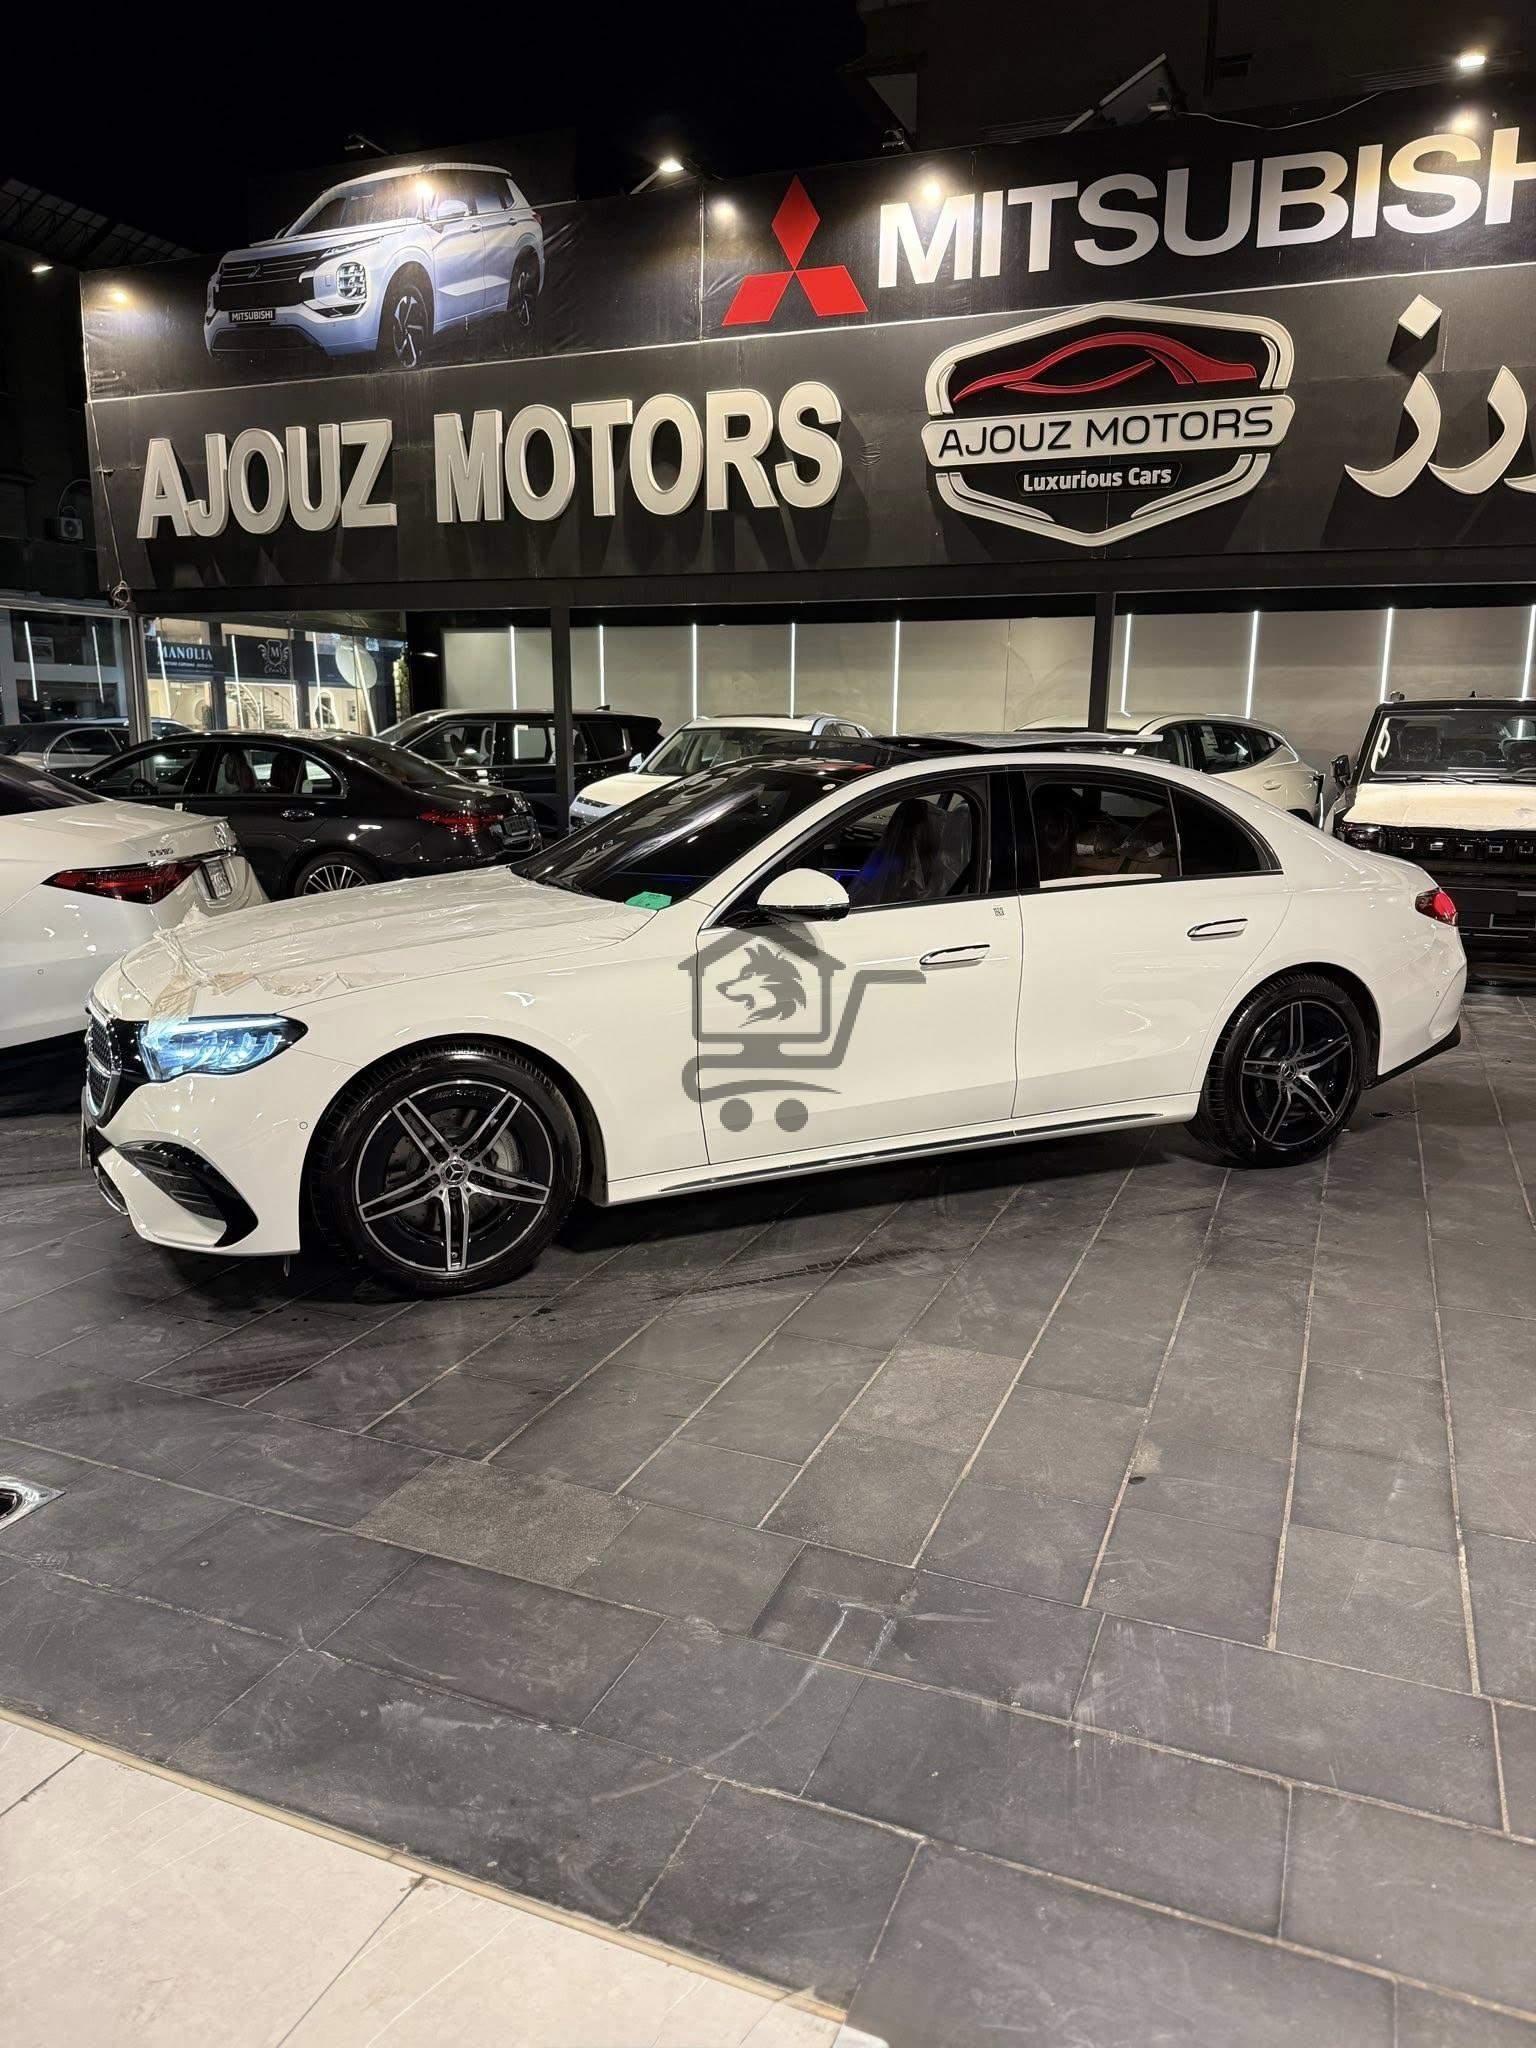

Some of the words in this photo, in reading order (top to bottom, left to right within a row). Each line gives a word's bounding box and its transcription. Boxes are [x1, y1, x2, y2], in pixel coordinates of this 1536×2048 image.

[231, 310, 273, 321] MITSUBISHI
[1344, 293, 1536, 498] رز
[938, 421, 1072, 458] AJOUZ
[1086, 406, 1273, 448] MOTORS
[136, 418, 398, 539] AJOUZ
[433, 381, 842, 524] MOTORS
[1023, 472, 1122, 492] Luxurious
[1128, 466, 1172, 486] Cars
